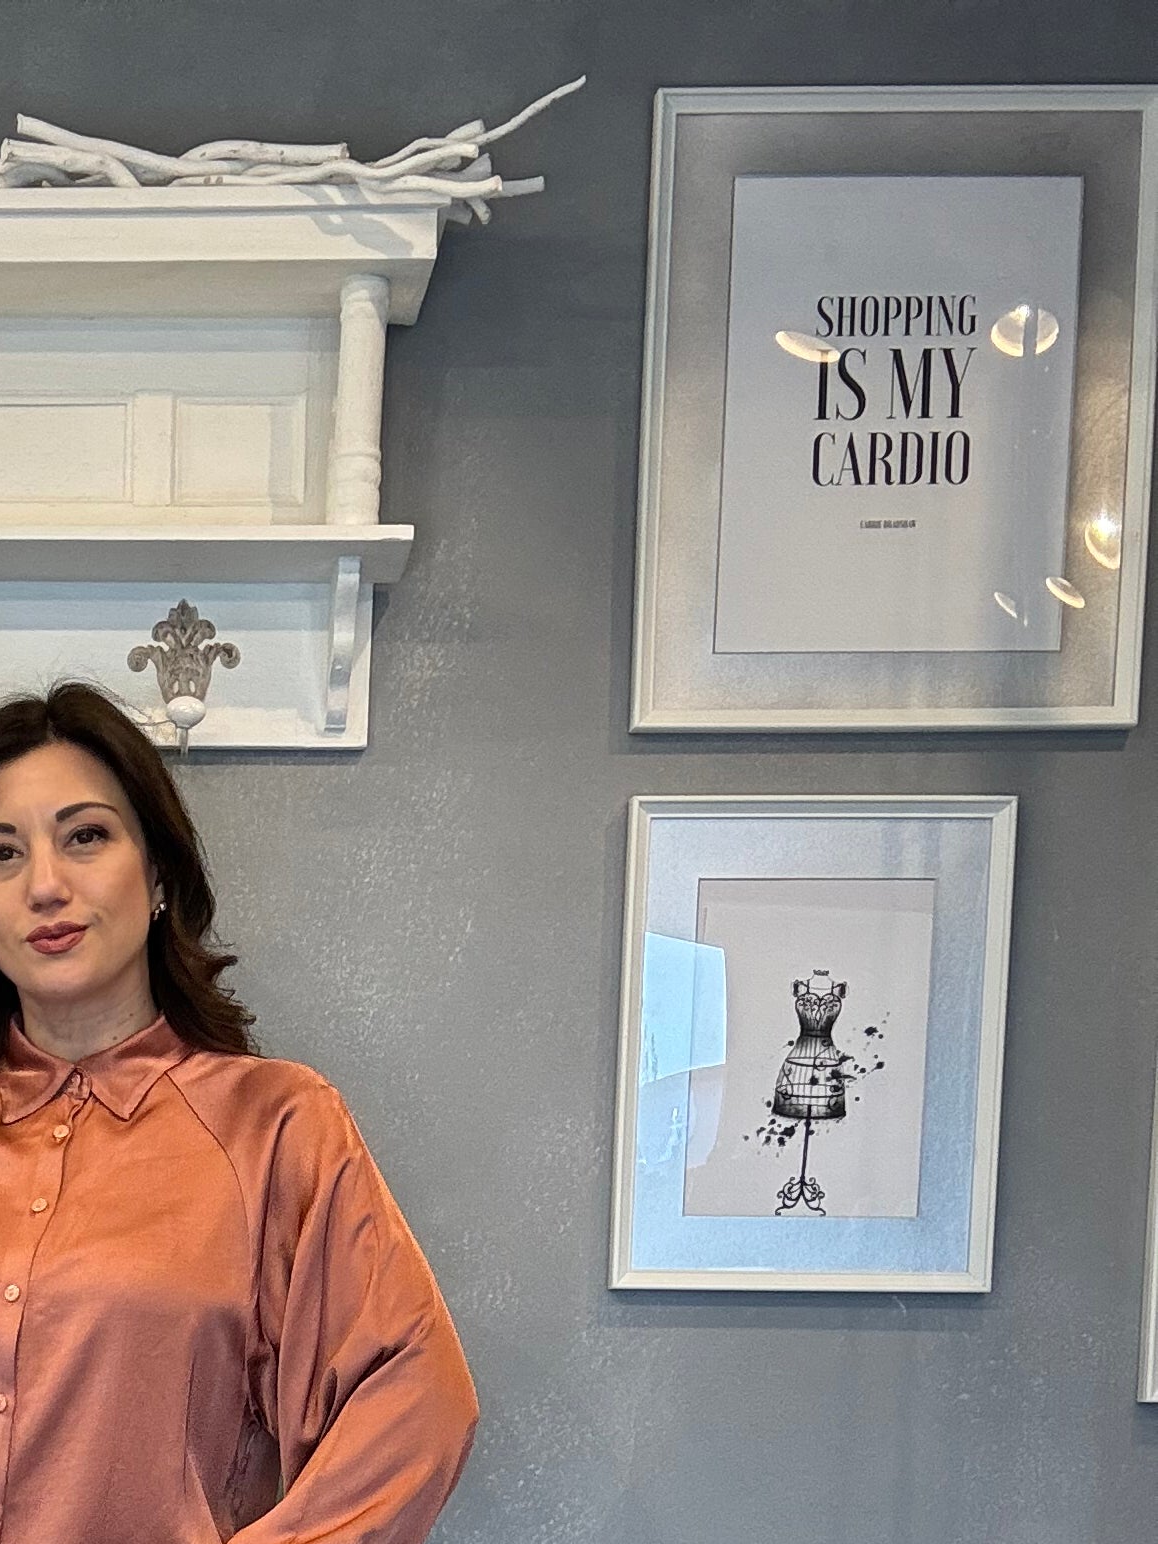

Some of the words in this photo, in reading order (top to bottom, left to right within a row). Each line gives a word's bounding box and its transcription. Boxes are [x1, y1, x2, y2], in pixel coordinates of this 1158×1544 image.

[816, 294, 977, 337] SHOPPING
[813, 347, 867, 421] IS
[886, 347, 978, 420] MY
[812, 430, 971, 487] CARDIO
